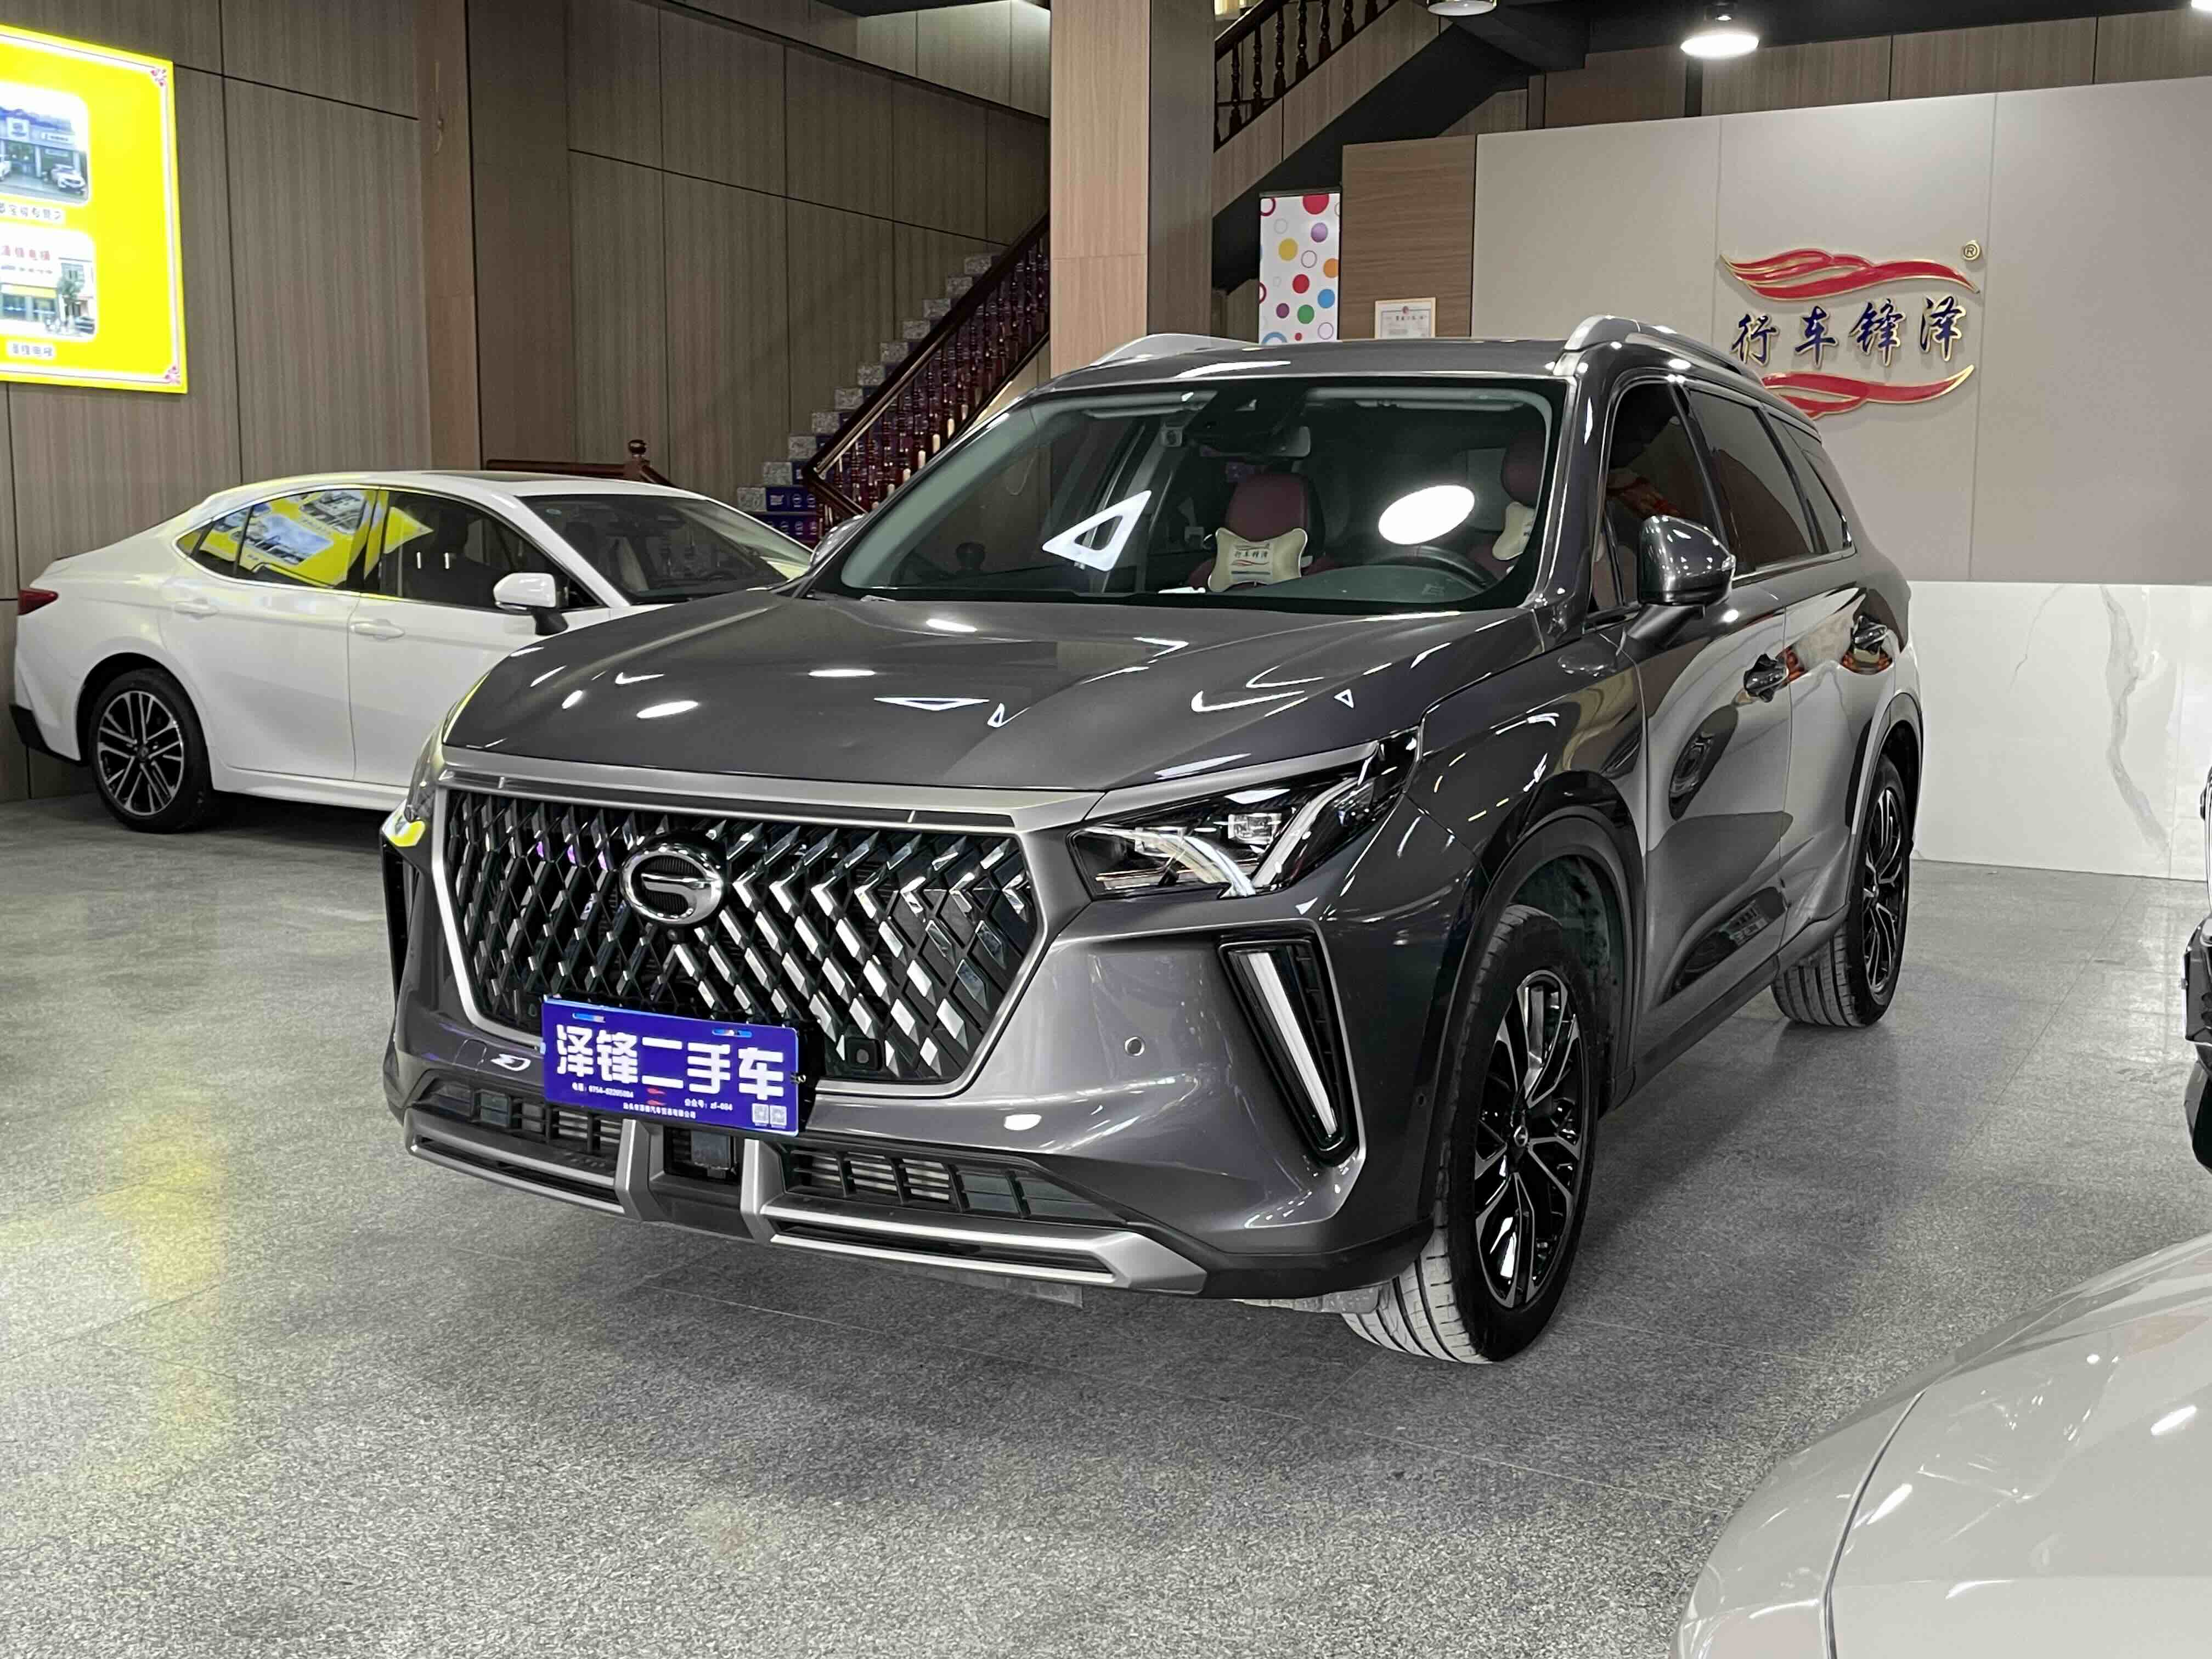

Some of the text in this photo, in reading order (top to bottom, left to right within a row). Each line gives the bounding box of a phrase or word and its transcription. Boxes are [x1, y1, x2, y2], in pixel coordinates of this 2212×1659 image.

[556, 1024, 785, 1101] 泽锋二手车
